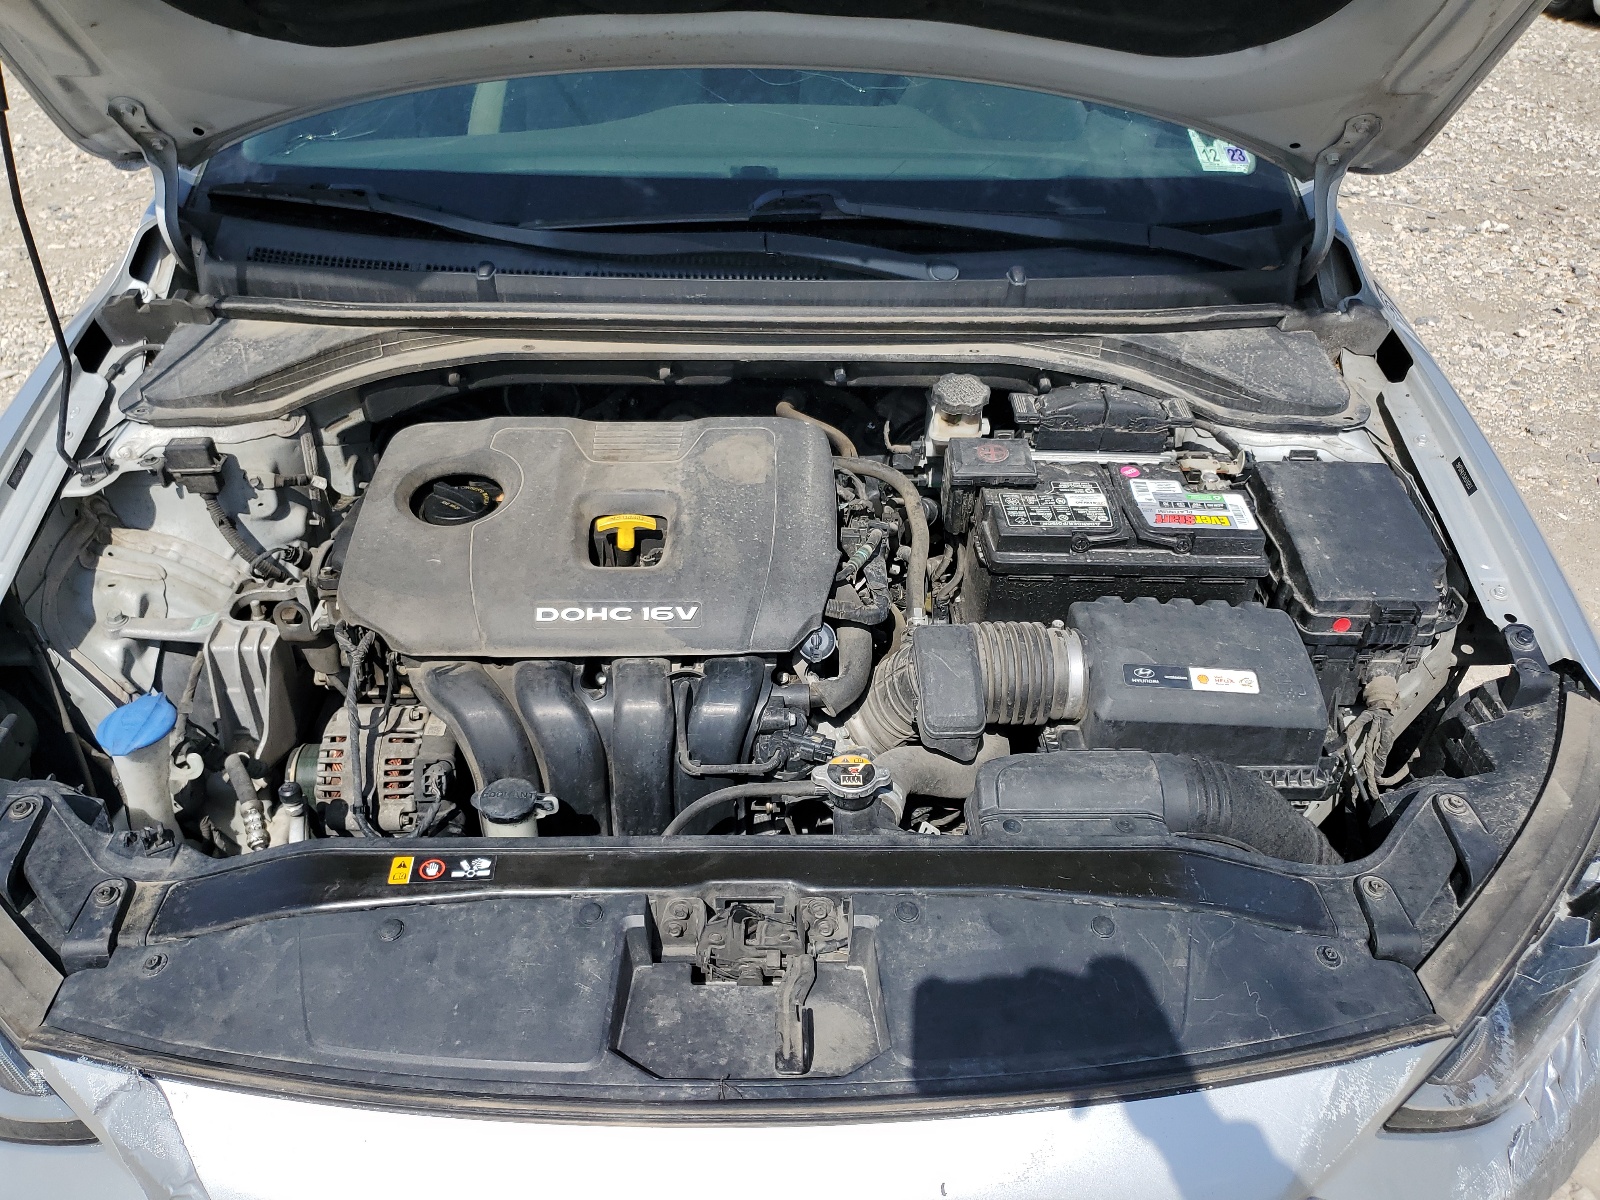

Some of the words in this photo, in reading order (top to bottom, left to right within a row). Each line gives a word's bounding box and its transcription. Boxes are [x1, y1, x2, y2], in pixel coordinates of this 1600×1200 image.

[1201, 148, 1220, 162] 12
[1227, 148, 1246, 162] 23
[1154, 513, 1231, 527] EverStart
[535, 607, 633, 621] DOHC
[642, 606, 699, 621] 16V
[483, 791, 536, 799] COOLANT
